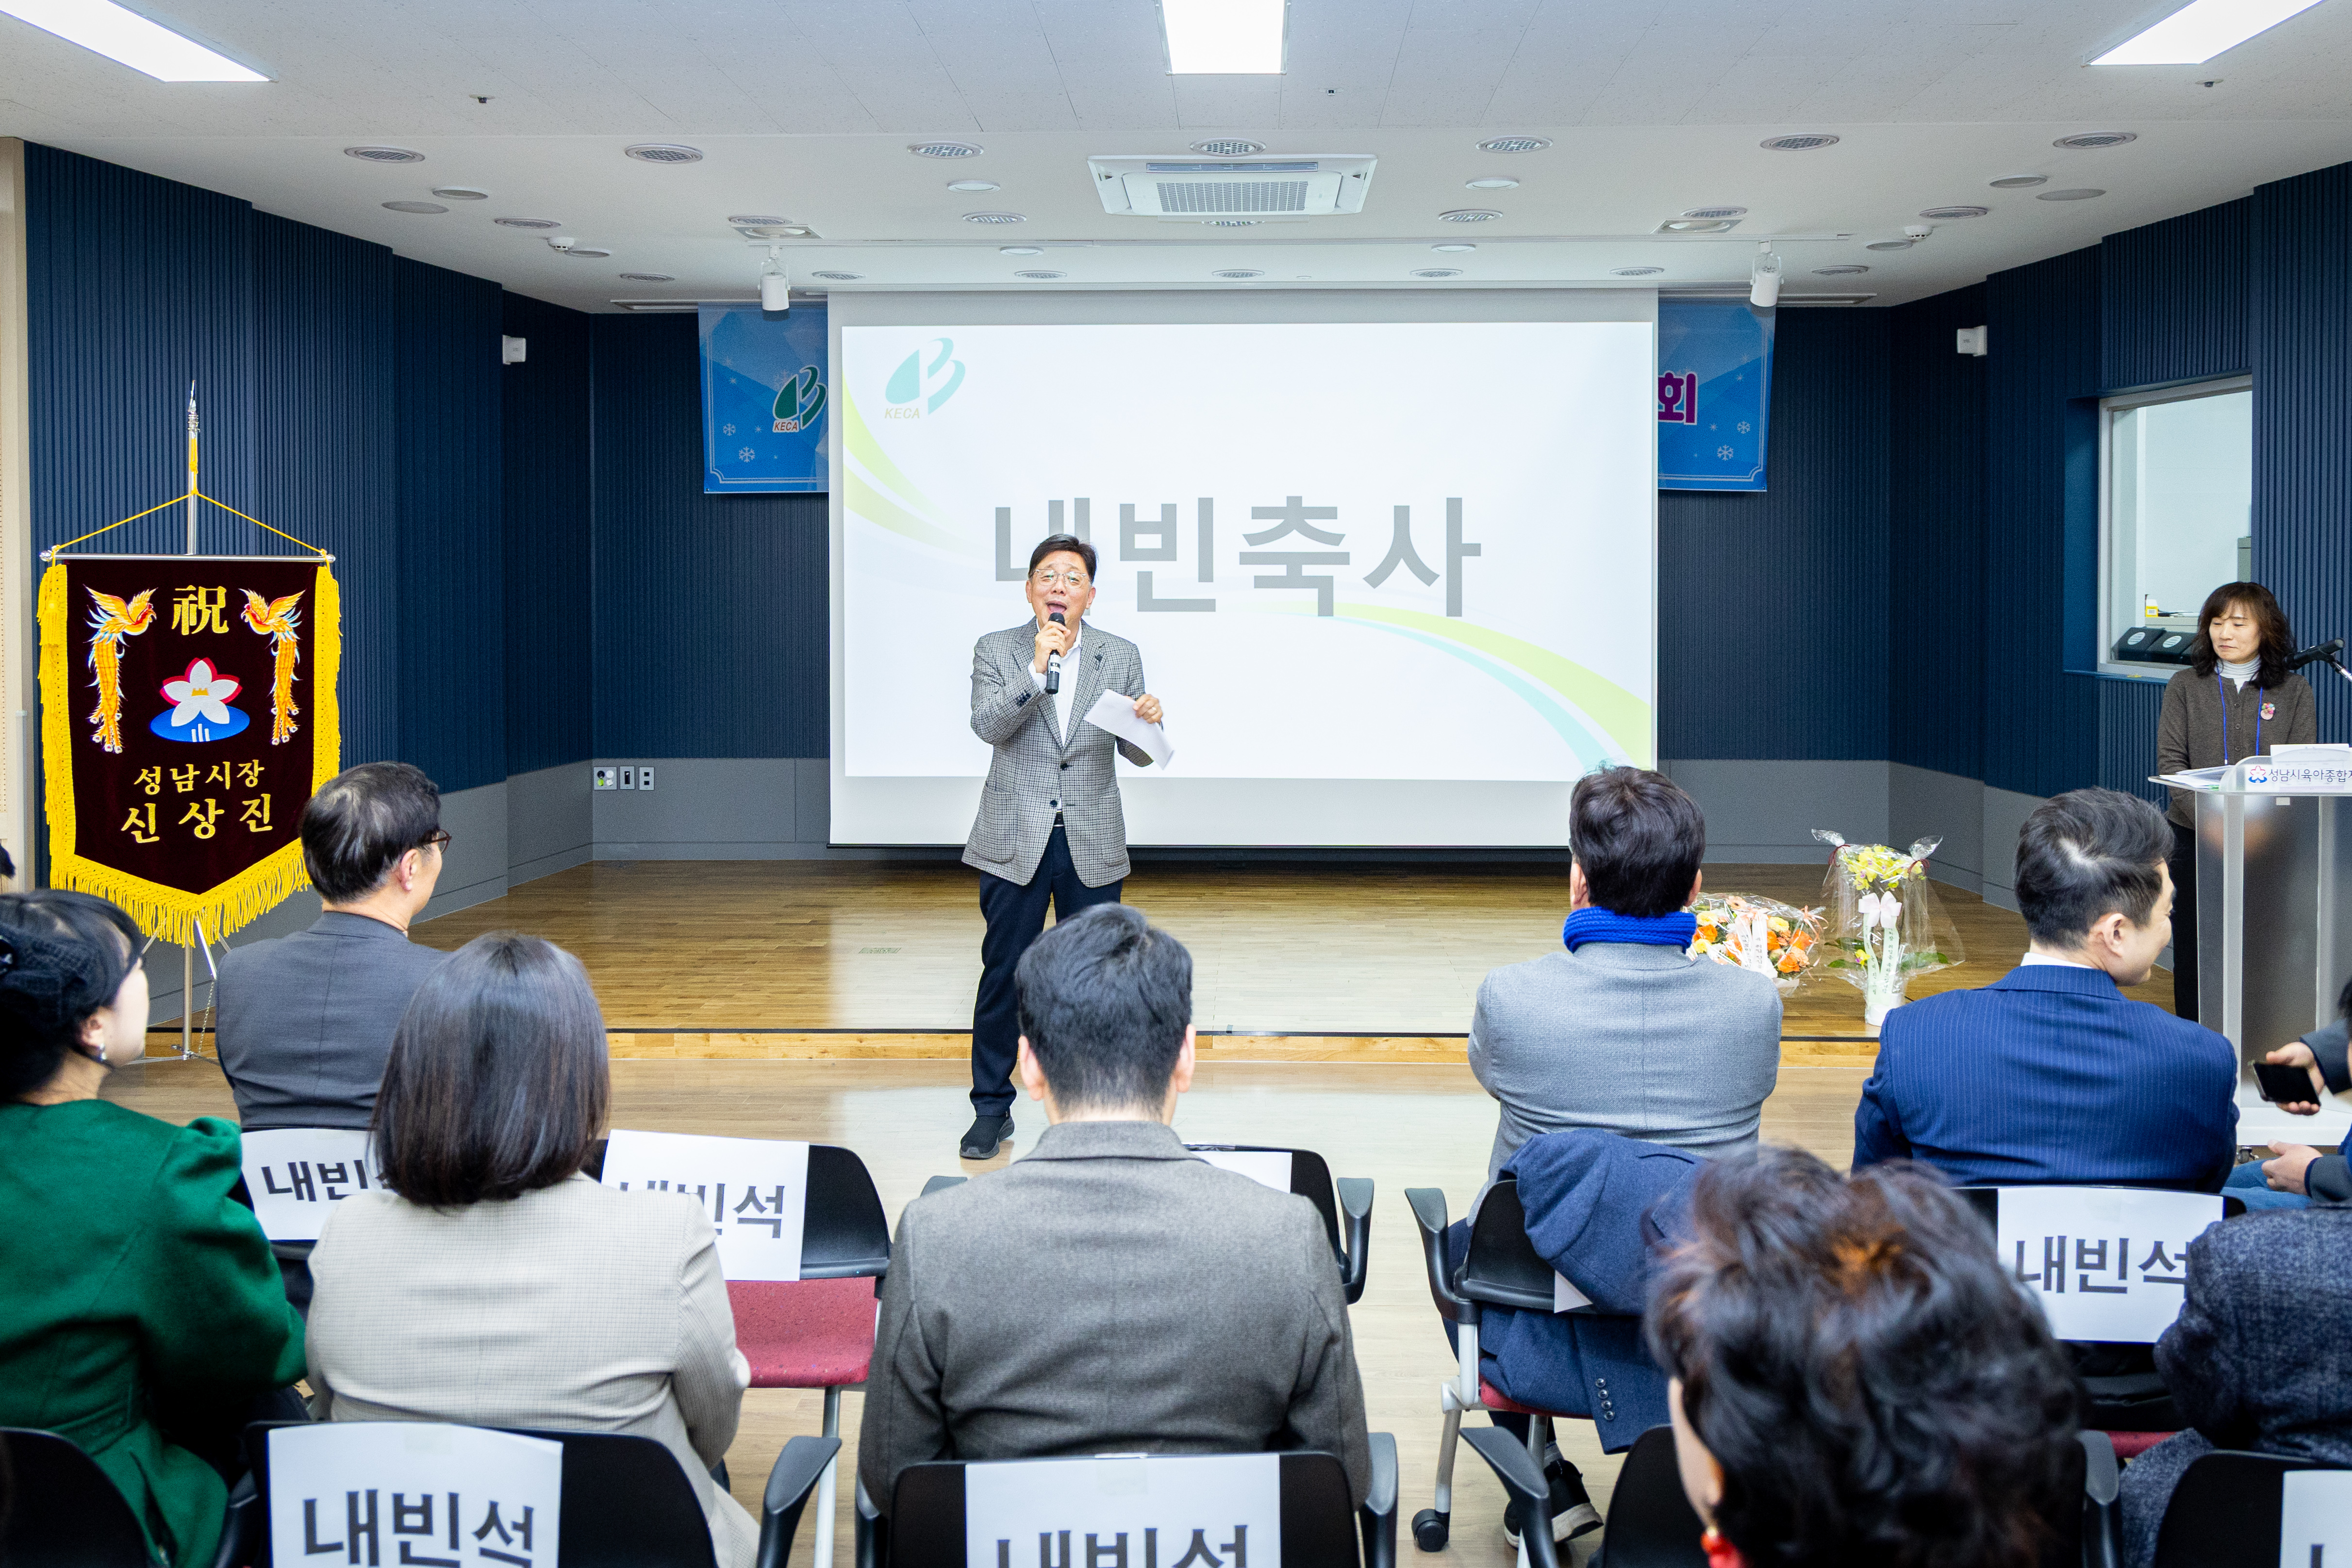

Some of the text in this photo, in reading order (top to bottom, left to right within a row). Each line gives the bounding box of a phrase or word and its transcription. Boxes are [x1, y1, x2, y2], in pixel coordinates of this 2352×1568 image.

[774, 421, 798, 431] KECA
[884, 408, 920, 419] KECA
[171, 584, 229, 635] 祝
[133, 759, 265, 795] 성남시장
[261, 1159, 389, 1202] 내빈
[2016, 1235, 2190, 1299] 내빈석
[302, 1489, 534, 1568] 내빈석
